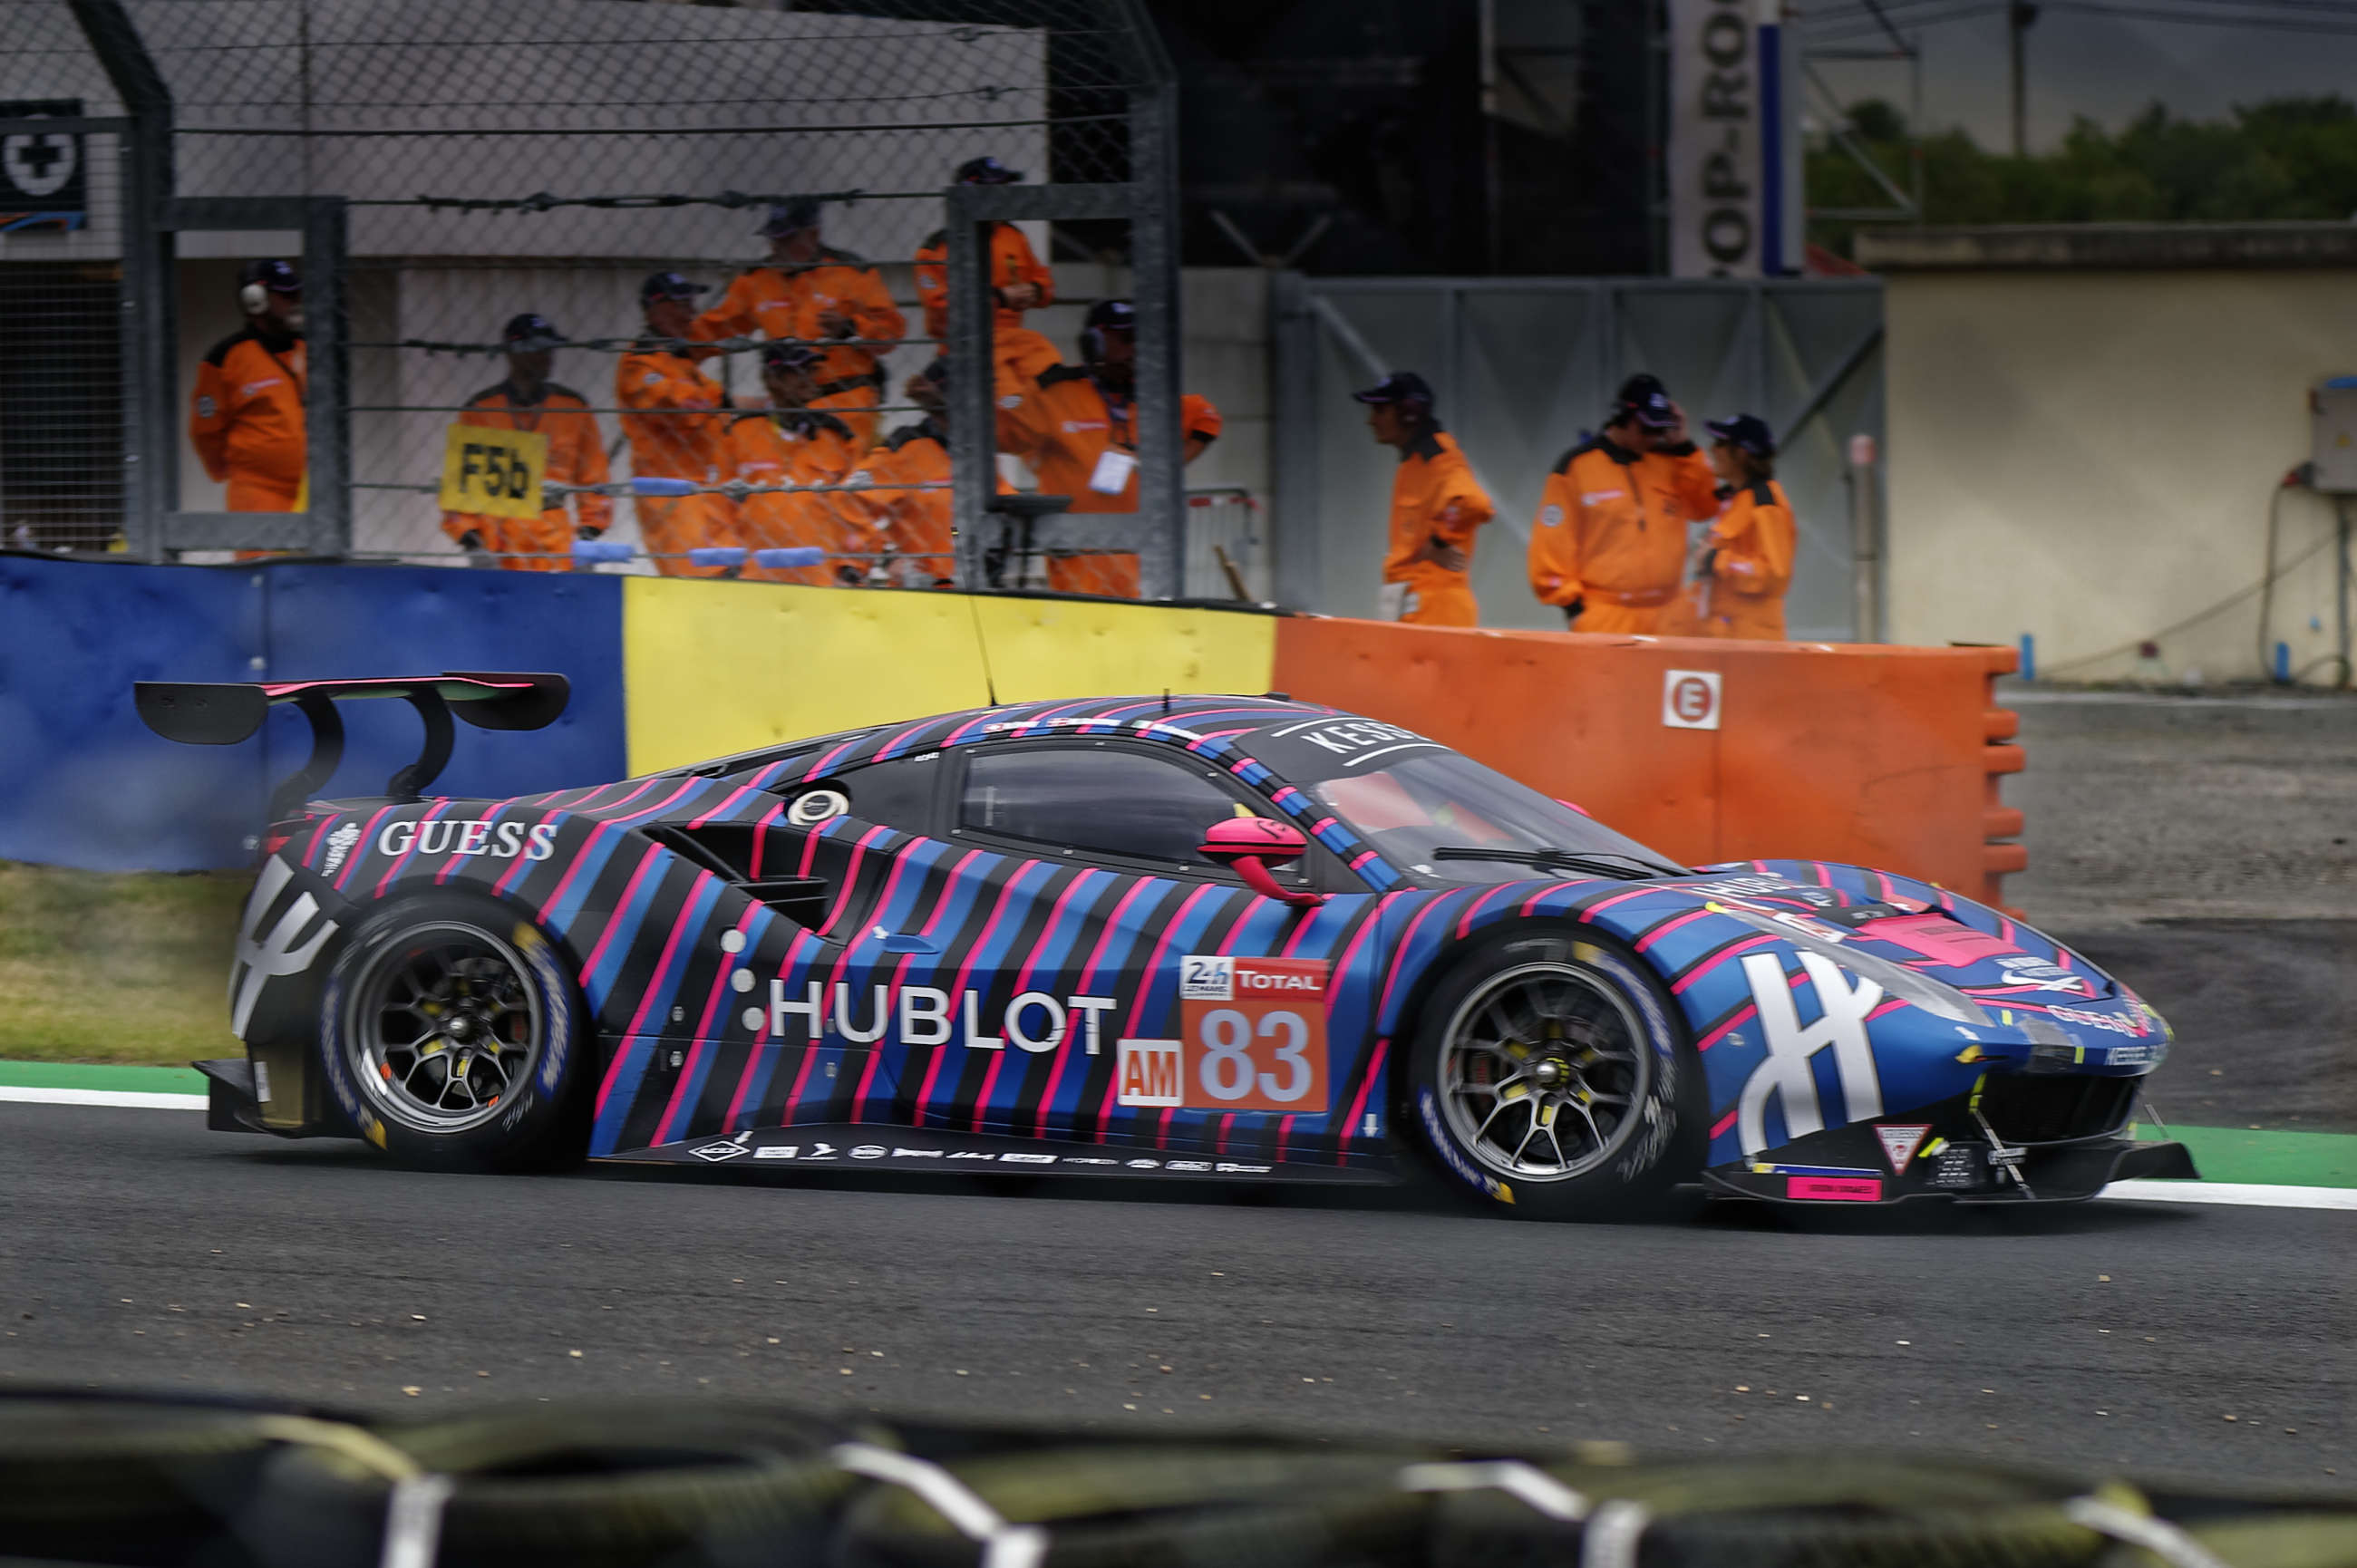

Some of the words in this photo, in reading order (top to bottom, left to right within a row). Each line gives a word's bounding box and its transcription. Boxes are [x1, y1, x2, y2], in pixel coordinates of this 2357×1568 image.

[1698, 0, 1751, 279] OP-RO
[460, 443, 530, 498] F5b
[1681, 682, 1705, 716] E
[377, 820, 558, 861] GUESS
[1235, 970, 1323, 991] TOTAL
[769, 978, 1118, 1055] HUBLOT
[1123, 1050, 1178, 1098] AM
[1198, 1008, 1314, 1103] 83
